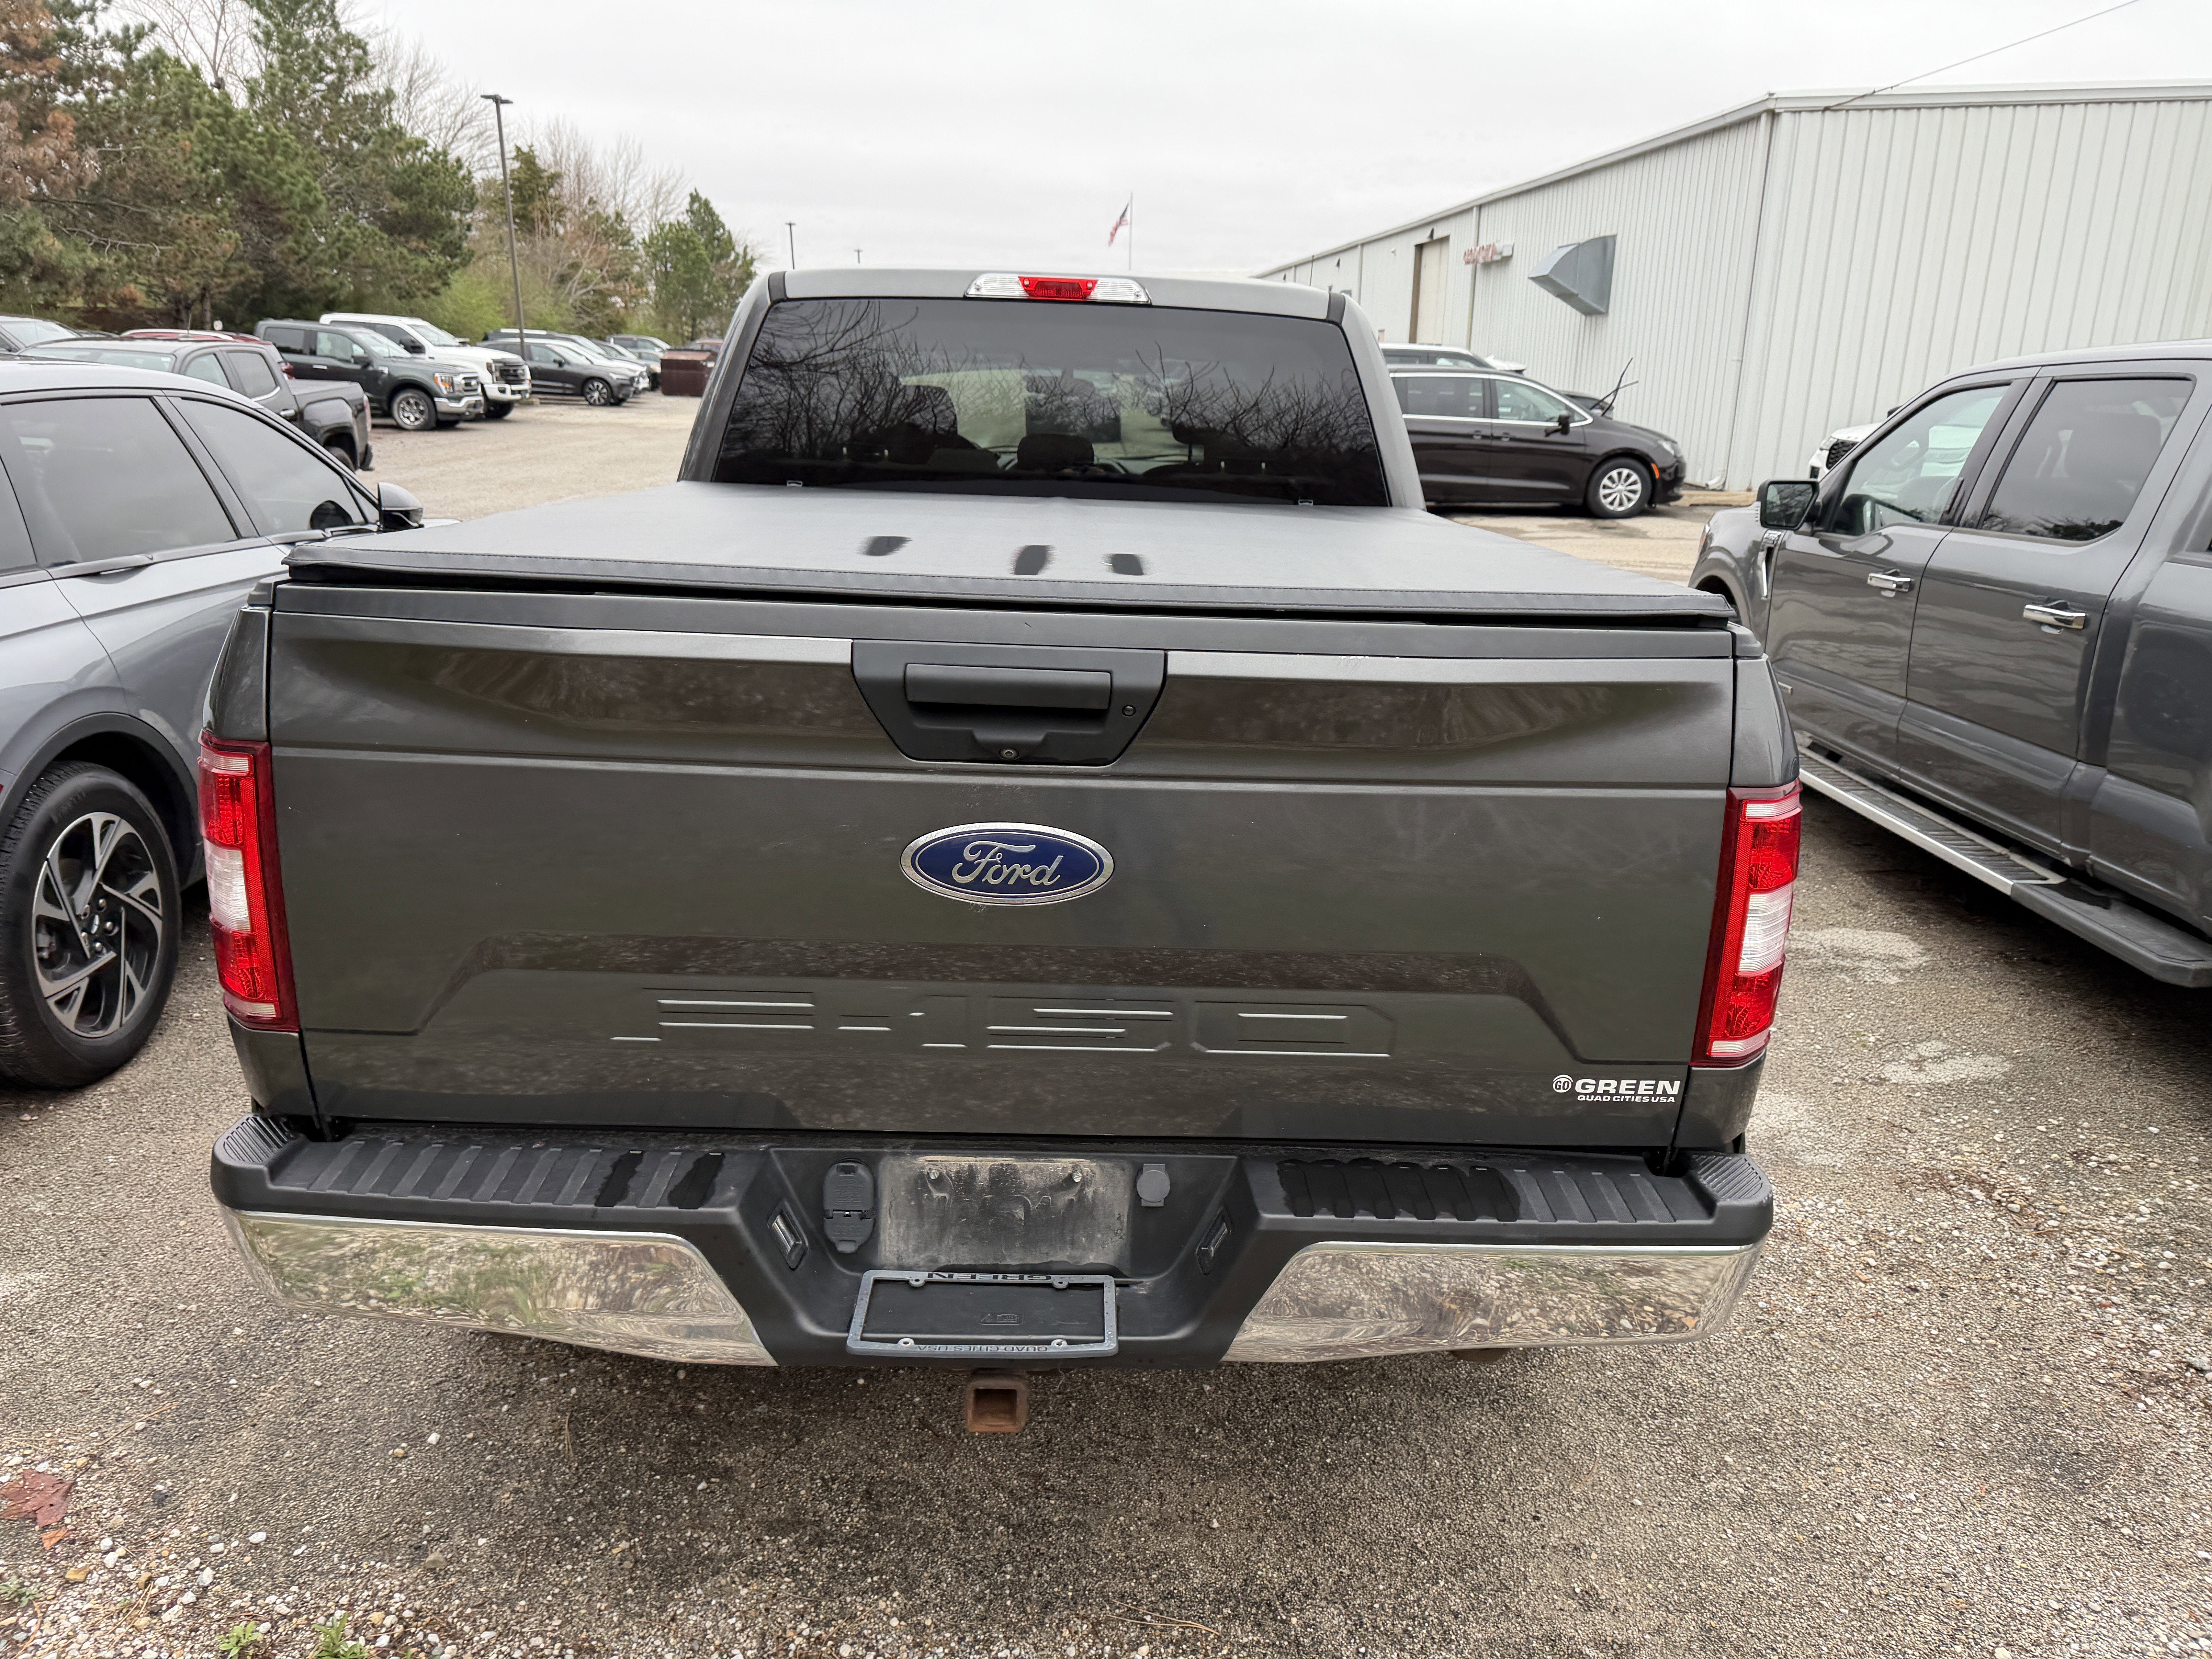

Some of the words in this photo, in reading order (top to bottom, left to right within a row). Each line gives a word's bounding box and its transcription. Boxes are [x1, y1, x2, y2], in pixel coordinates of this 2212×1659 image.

[951, 840, 1064, 886] Ford
[1554, 1080, 1570, 1091] GO
[1575, 1079, 1681, 1095] GREEN
[927, 1273, 1052, 1281] GREEN
